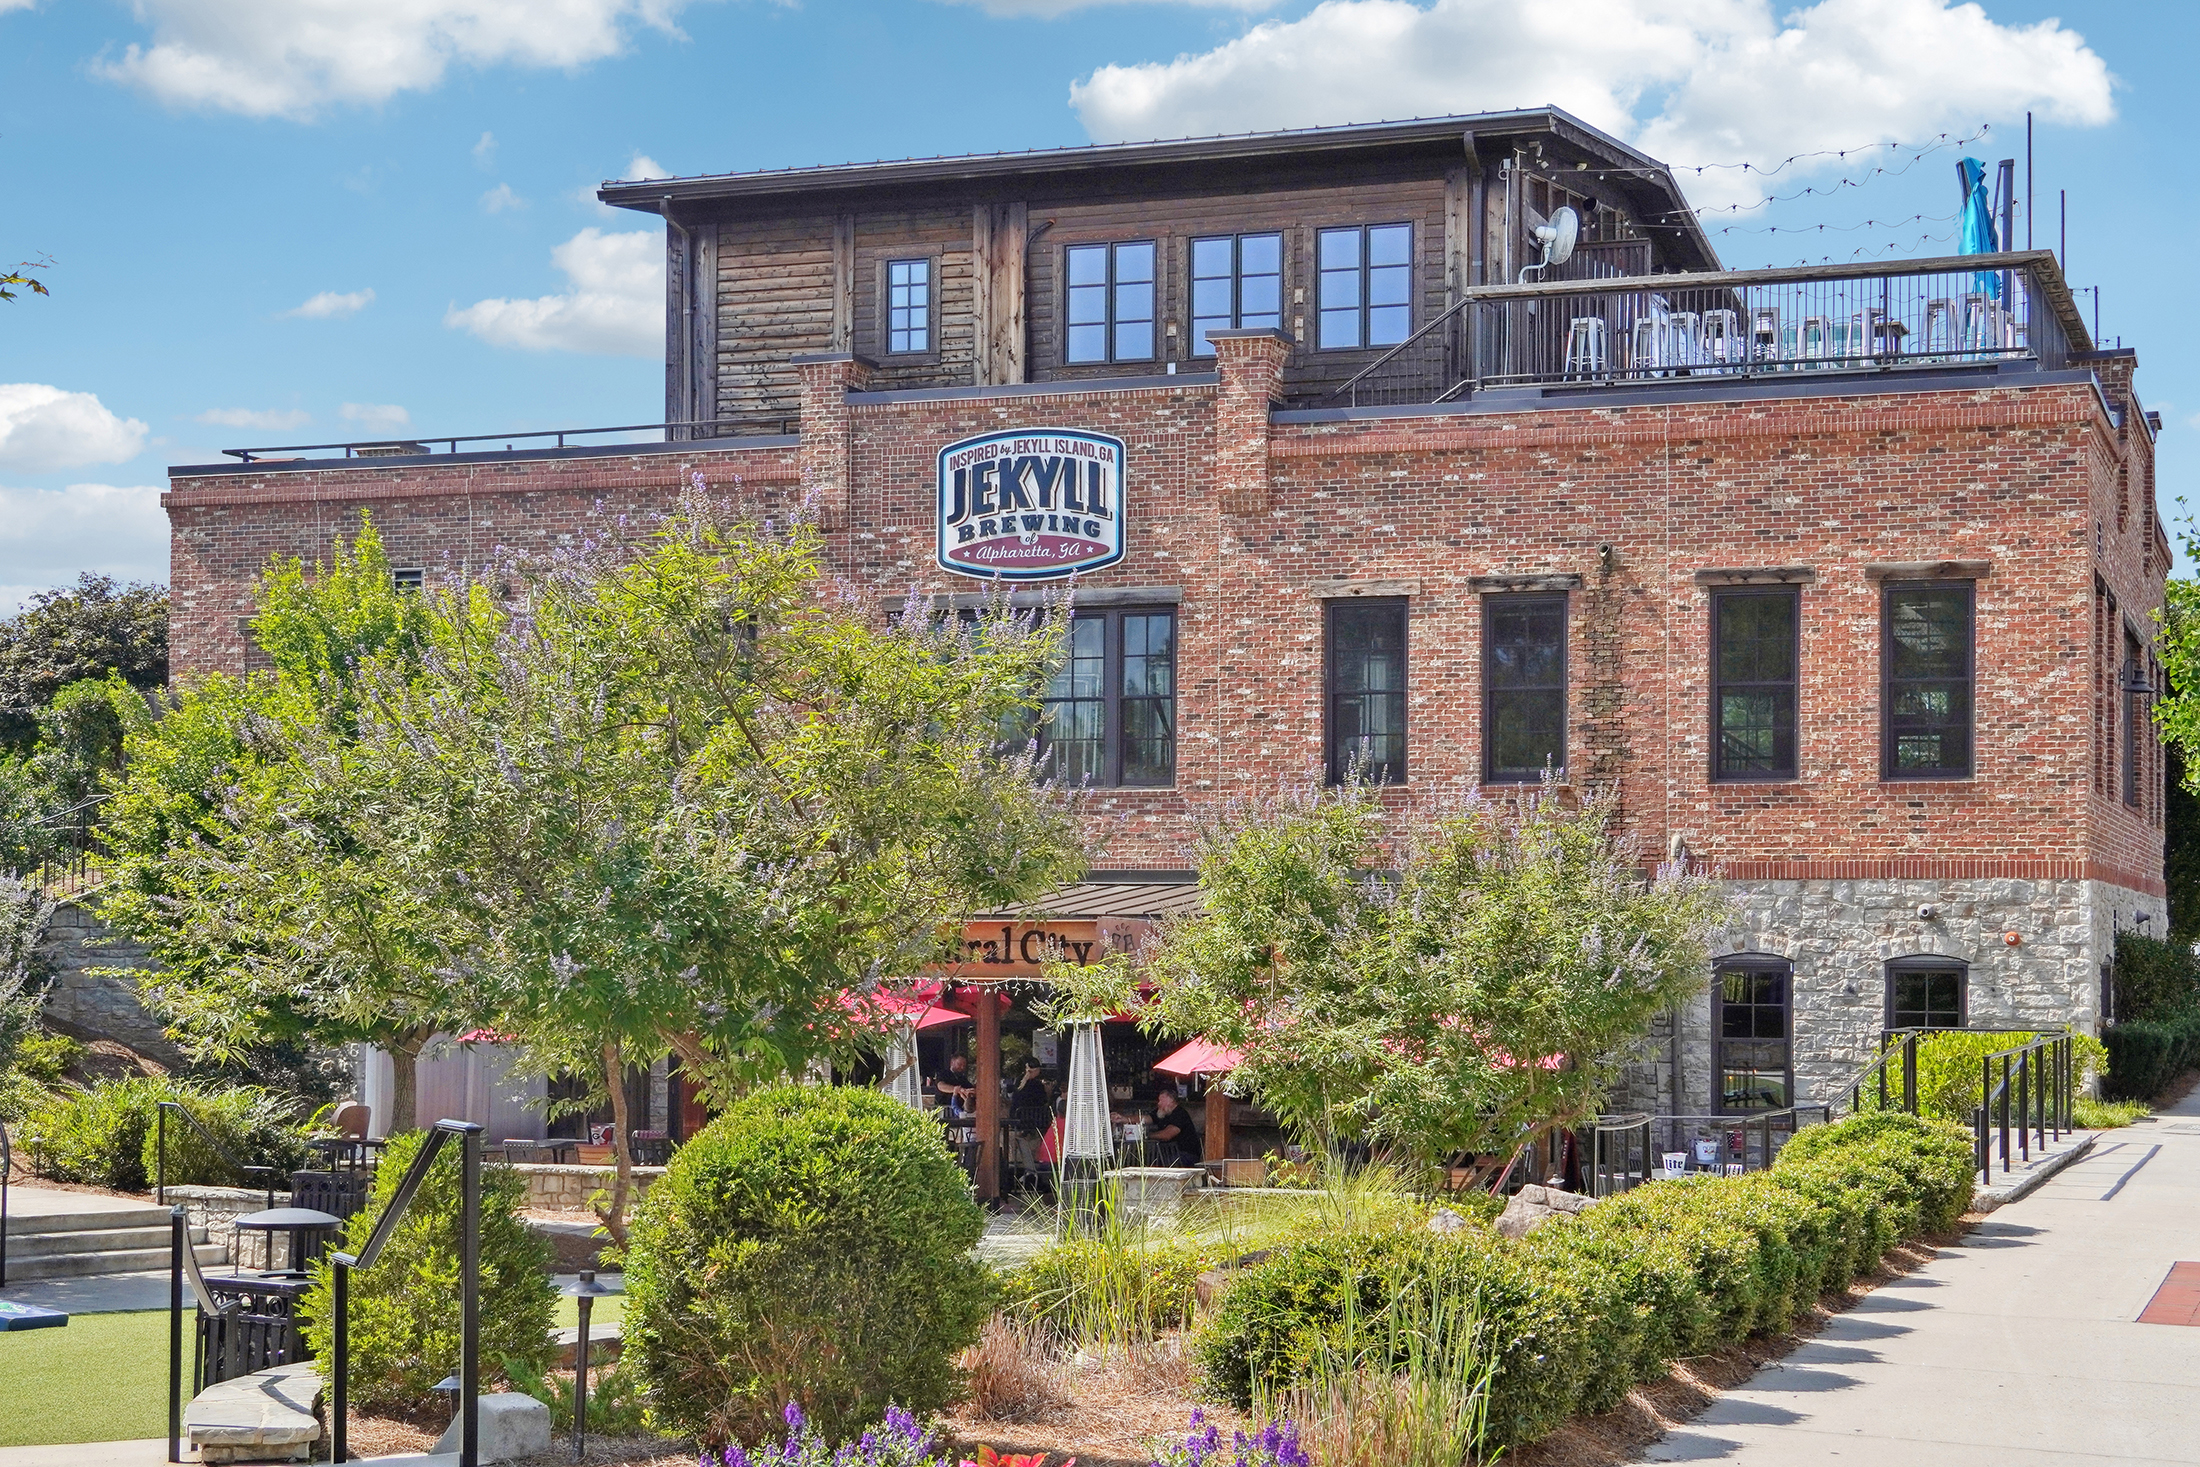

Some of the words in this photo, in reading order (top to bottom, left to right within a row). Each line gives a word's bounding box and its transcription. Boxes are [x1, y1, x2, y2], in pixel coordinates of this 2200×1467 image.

[950, 443, 998, 471] INSPIRED
[1000, 444, 1011, 456] by
[1011, 439, 1051, 455] JEKYLL
[1099, 446, 1114, 463] GA
[947, 455, 1112, 526] JEKYLL
[957, 514, 1101, 543] BREWING
[1025, 532, 1036, 545] of
[976, 545, 1056, 563] Alpharetta,
[1058, 542, 1081, 559] GA
[1665, 1159, 1683, 1171] Lite
